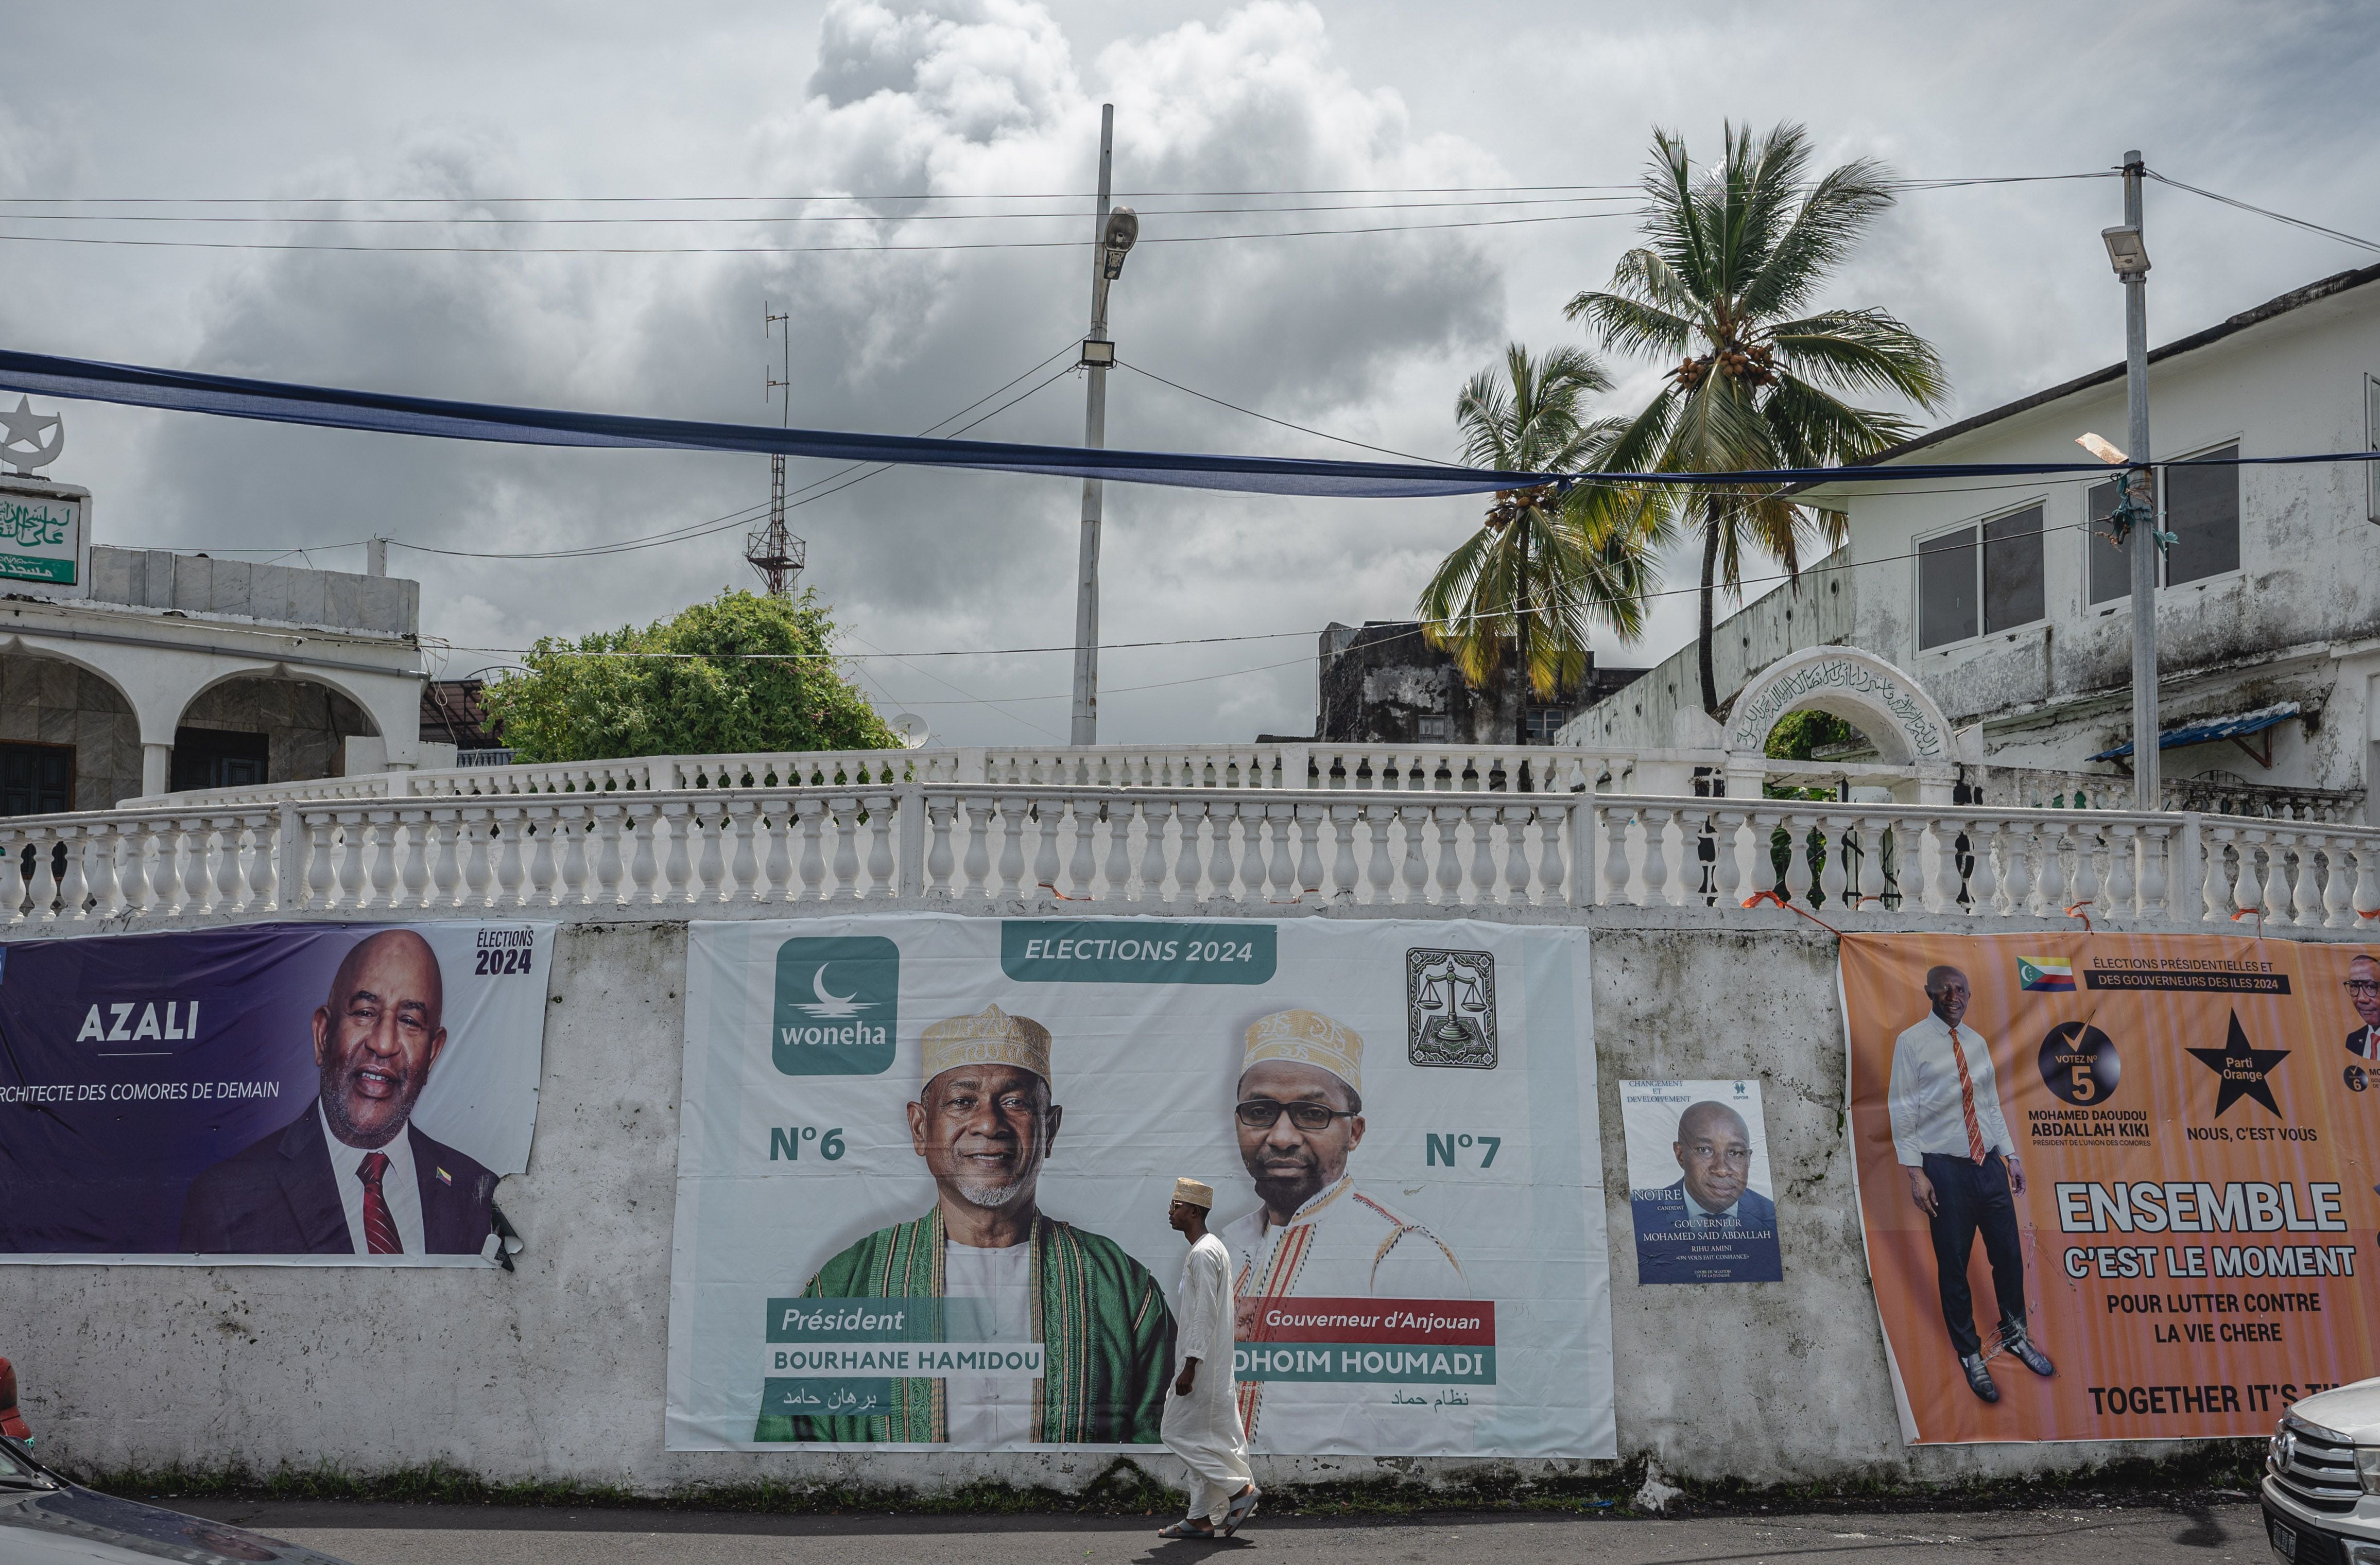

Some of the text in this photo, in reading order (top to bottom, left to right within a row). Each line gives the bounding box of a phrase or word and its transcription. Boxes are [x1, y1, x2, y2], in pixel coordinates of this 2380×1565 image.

[8, 564, 53, 577] مسجد
[477, 928, 533, 947] ÉLECTIONS
[1025, 939, 1253, 962] ELECTIONS 2024
[475, 949, 531, 975] 2024
[2093, 957, 2273, 972] ÉLECTIONS PRÉSIDENTIELLES ET
[2098, 975, 2279, 989] DES GOUVERNEURS DES ILES 2024
[76, 1001, 199, 1042] AZALI
[781, 1021, 886, 1045] woneha
[2226, 1057, 2253, 1068] Parti
[2072, 1066, 2095, 1101] 5
[2223, 1069, 2263, 1082] Orange
[2353, 1079, 2361, 1090] 6
[0, 1081, 280, 1102] RCHITECTE DES COMORES DE DEMAIN
[2028, 1110, 2147, 1121] MOHAMED DAOUDOU
[2031, 1123, 2149, 1137] ABDALLAH KIKI
[2187, 1127, 2317, 1142] NOUS, C'EST VOUS
[1633, 1189, 1682, 1202] NOTRE
[2055, 1182, 2347, 1233] ENSEMBLE
[1674, 1219, 1741, 1228] GOUVERNEUR
[1643, 1230, 1771, 1241] MOHAMED SAID ABDALLAH
[2064, 1246, 2356, 1278] C'EST LE MOMENT
[2107, 1293, 2321, 1313] POUR LUTTER CONTRE
[782, 1308, 905, 1331] Président
[1265, 1310, 1480, 1333] Gouverneur d'Anjouan
[2154, 1323, 2282, 1343] LA VIE CHERE
[774, 1351, 1040, 1370] BOURHANE HAMIDOU
[1341, 1351, 1483, 1376] HOUMADI
[783, 1387, 821, 1404] حامد
[1391, 1388, 1469, 1414] نظام حماد
[2088, 1385, 2240, 1415] TOGETHER
